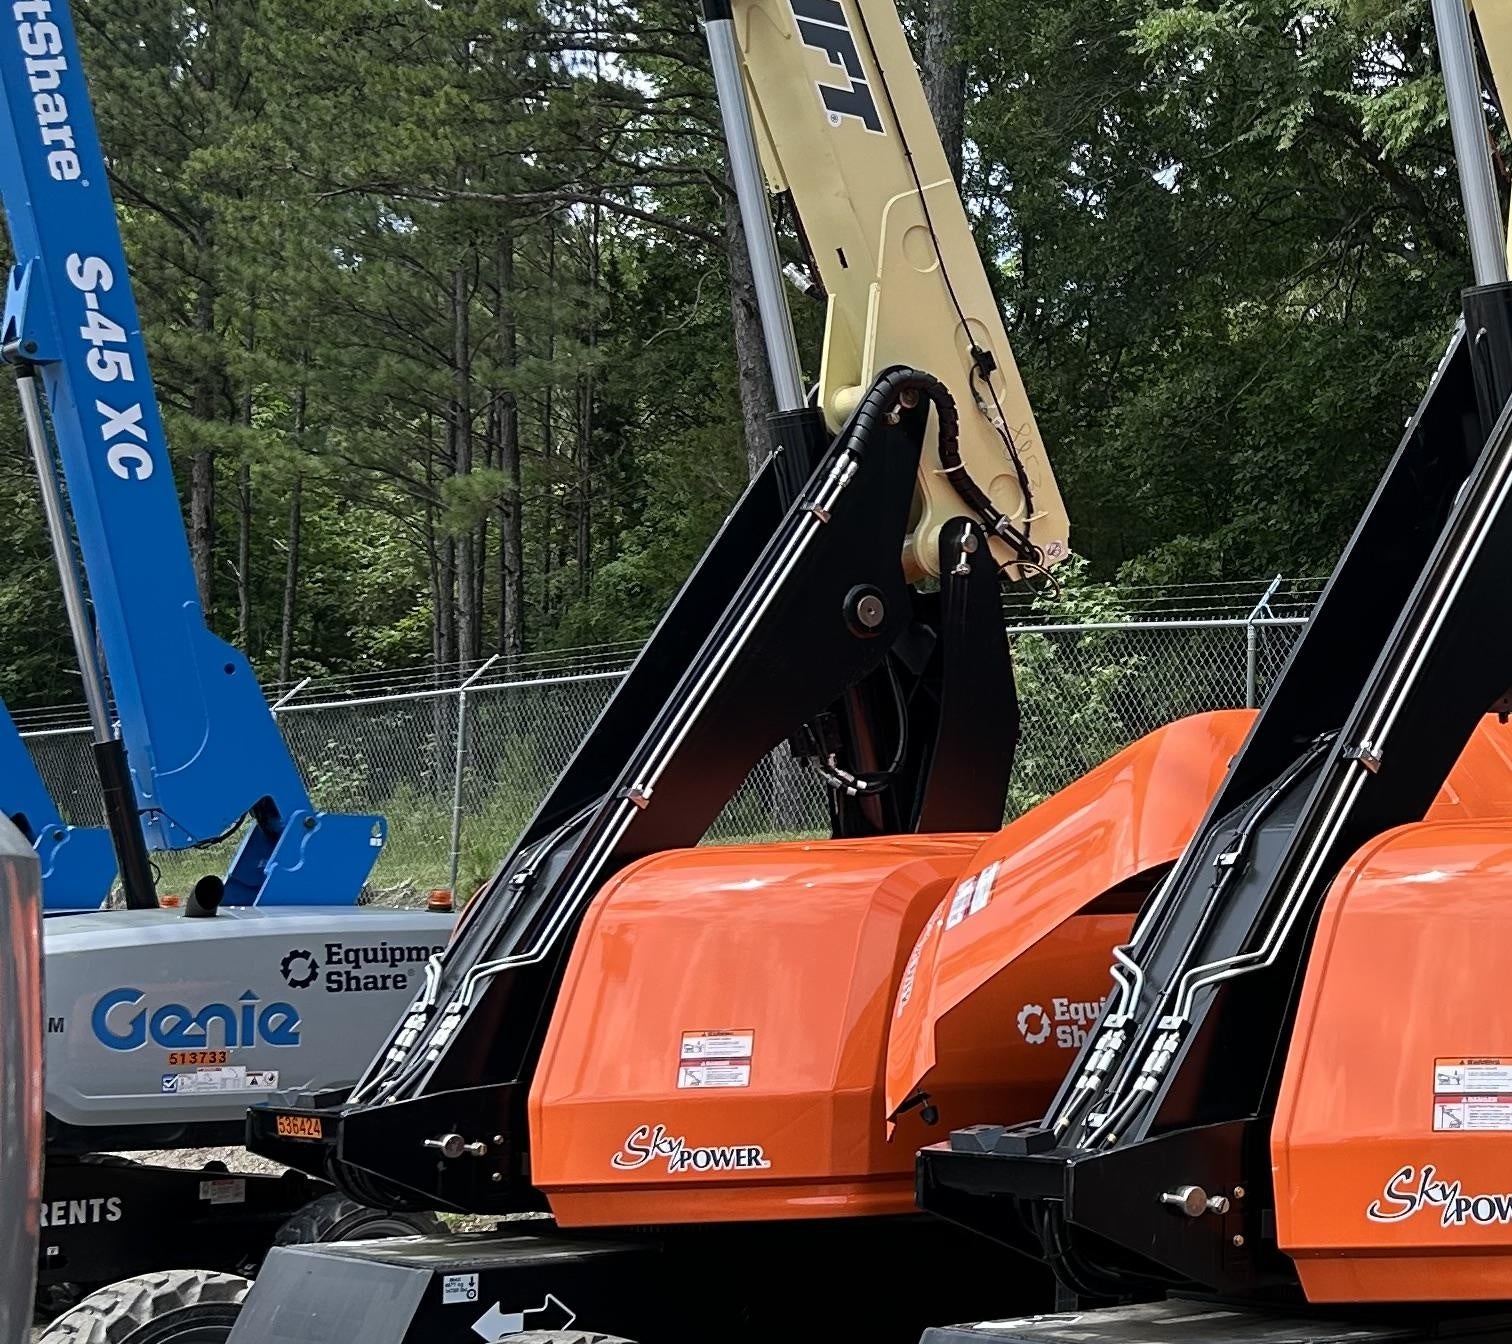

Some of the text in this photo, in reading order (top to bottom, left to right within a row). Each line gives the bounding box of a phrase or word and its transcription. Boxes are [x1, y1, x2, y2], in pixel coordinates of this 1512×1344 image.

[66, 252, 153, 481] S-45 XC
[326, 970, 408, 993] Share
[91, 988, 301, 1051] Genie
[278, 1116, 320, 1137] 536424
